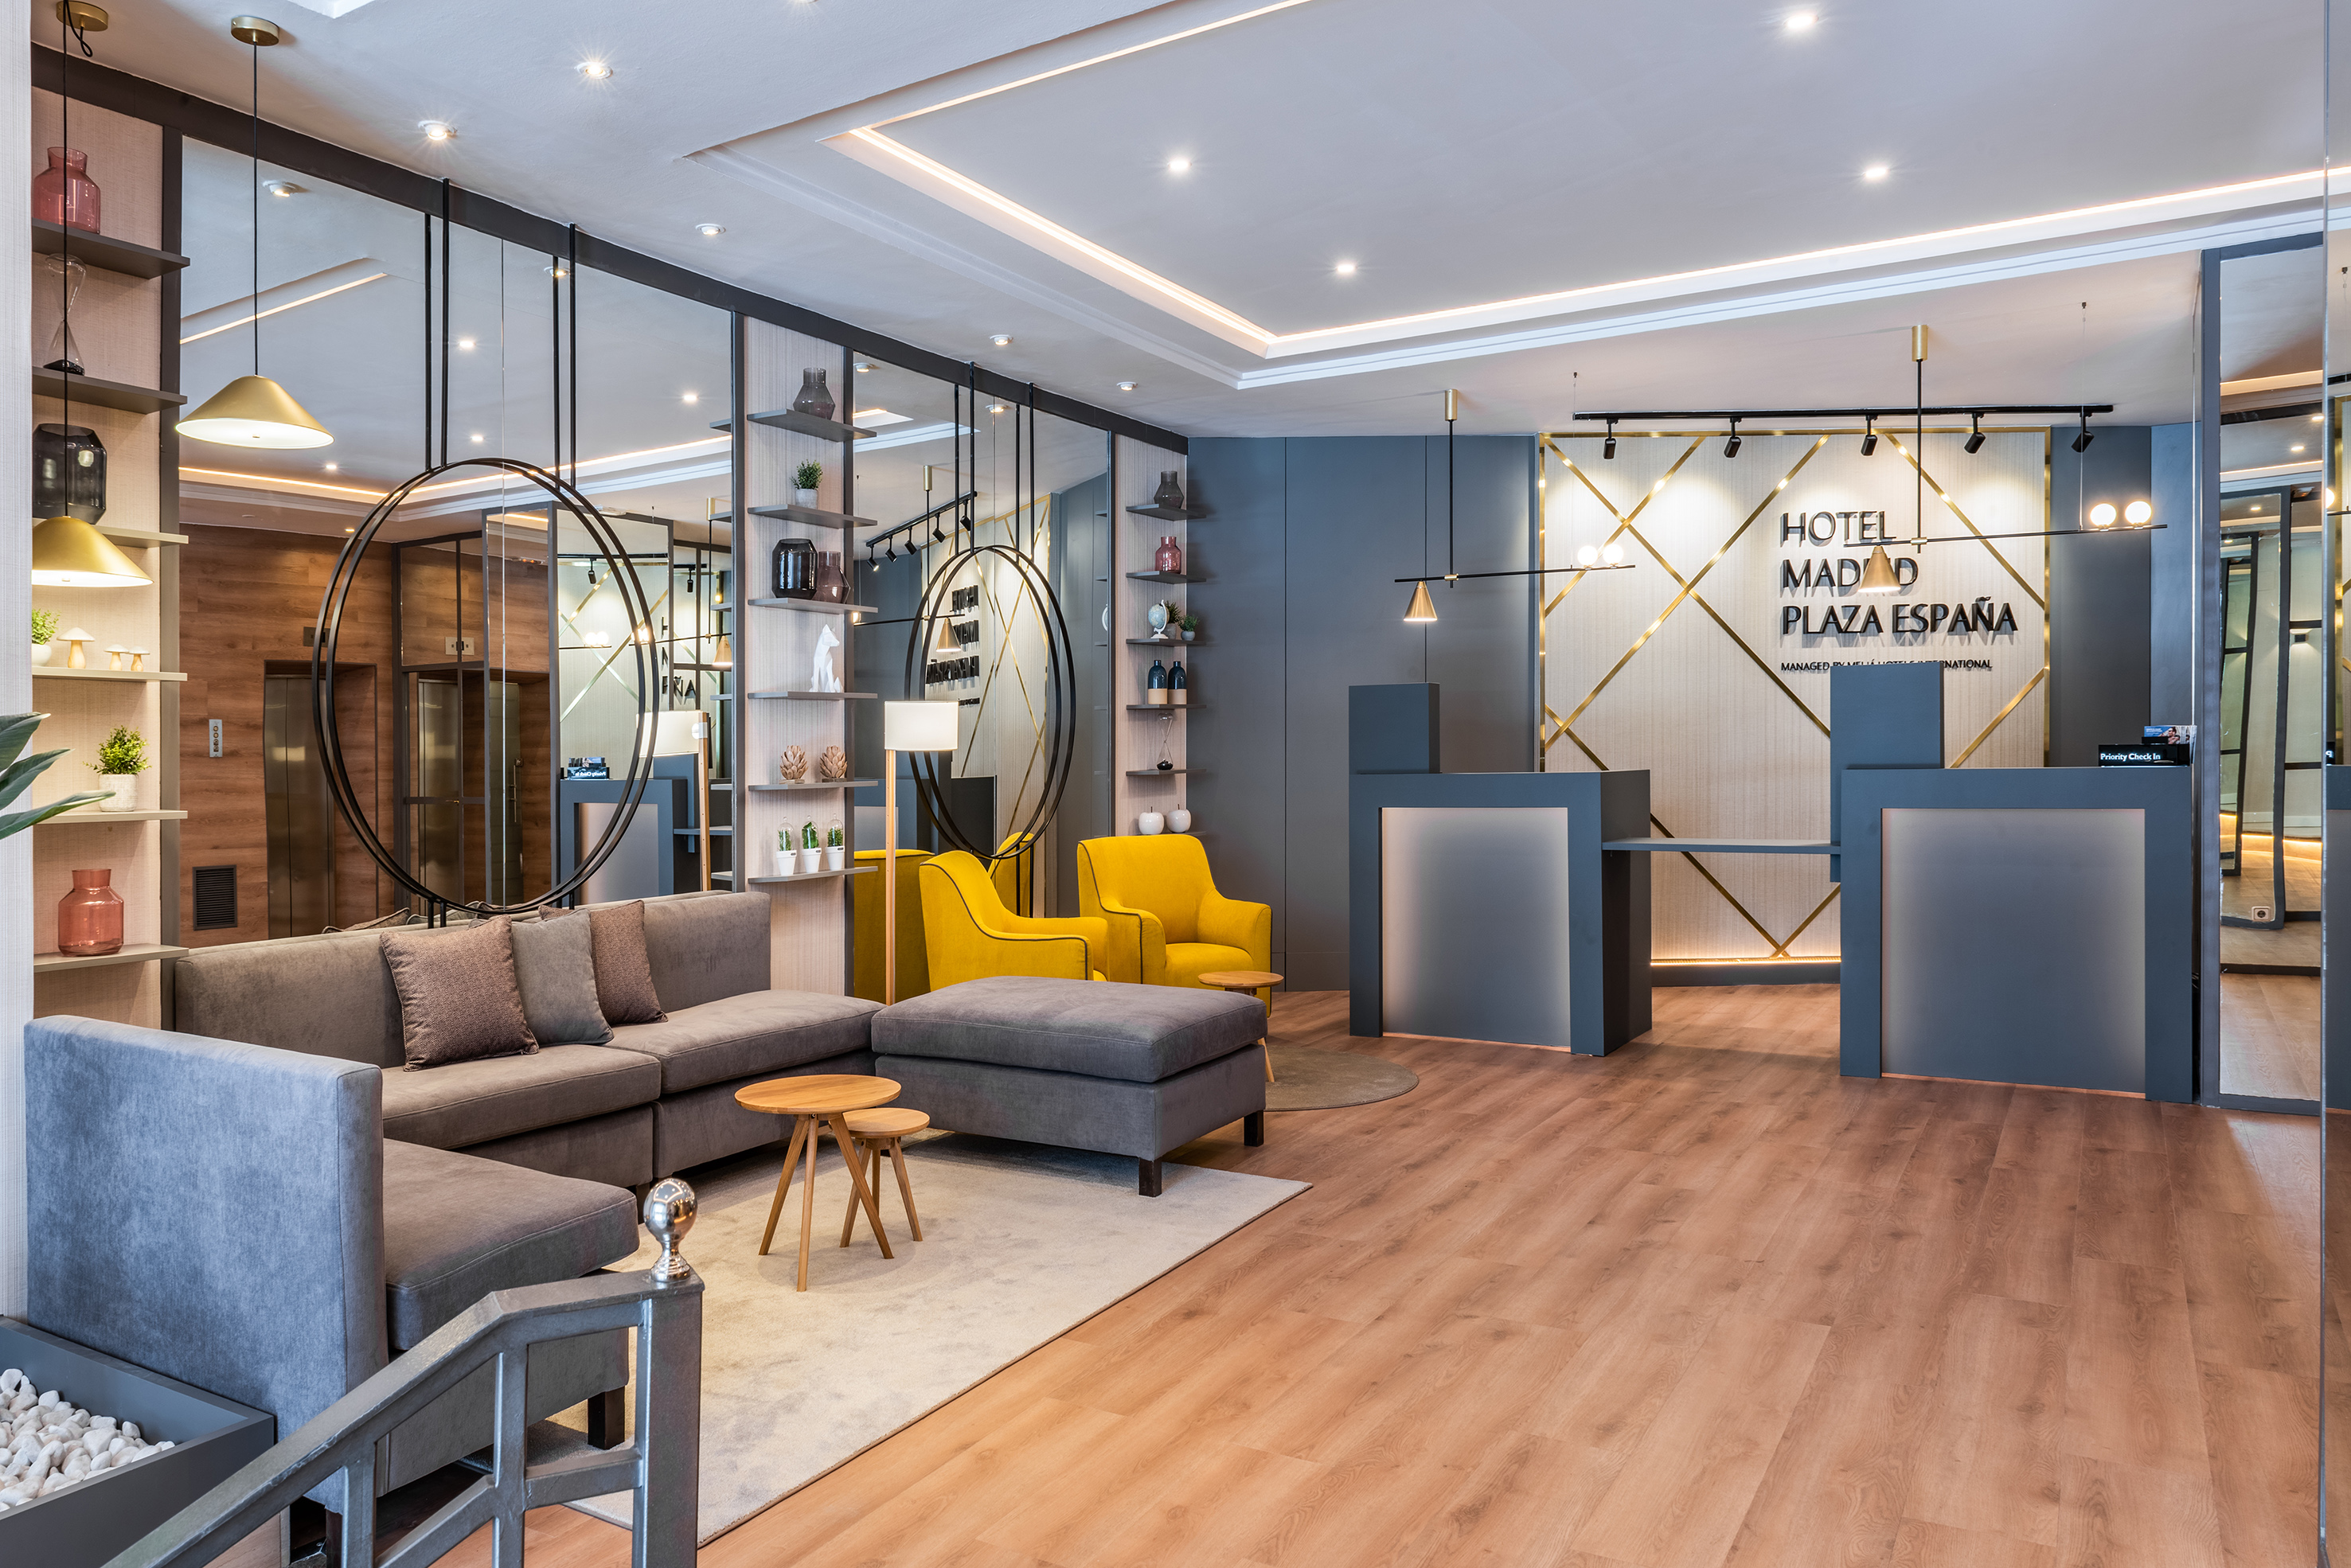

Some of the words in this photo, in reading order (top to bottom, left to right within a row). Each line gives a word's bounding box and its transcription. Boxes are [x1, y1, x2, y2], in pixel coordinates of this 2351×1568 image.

[1781, 510, 1896, 541] HOTEL
[1781, 557, 1919, 588] MADD
[1782, 604, 1884, 634] PLAZA
[1892, 596, 2019, 634] ESPAÑA
[1780, 661, 1830, 671] MANAGED
